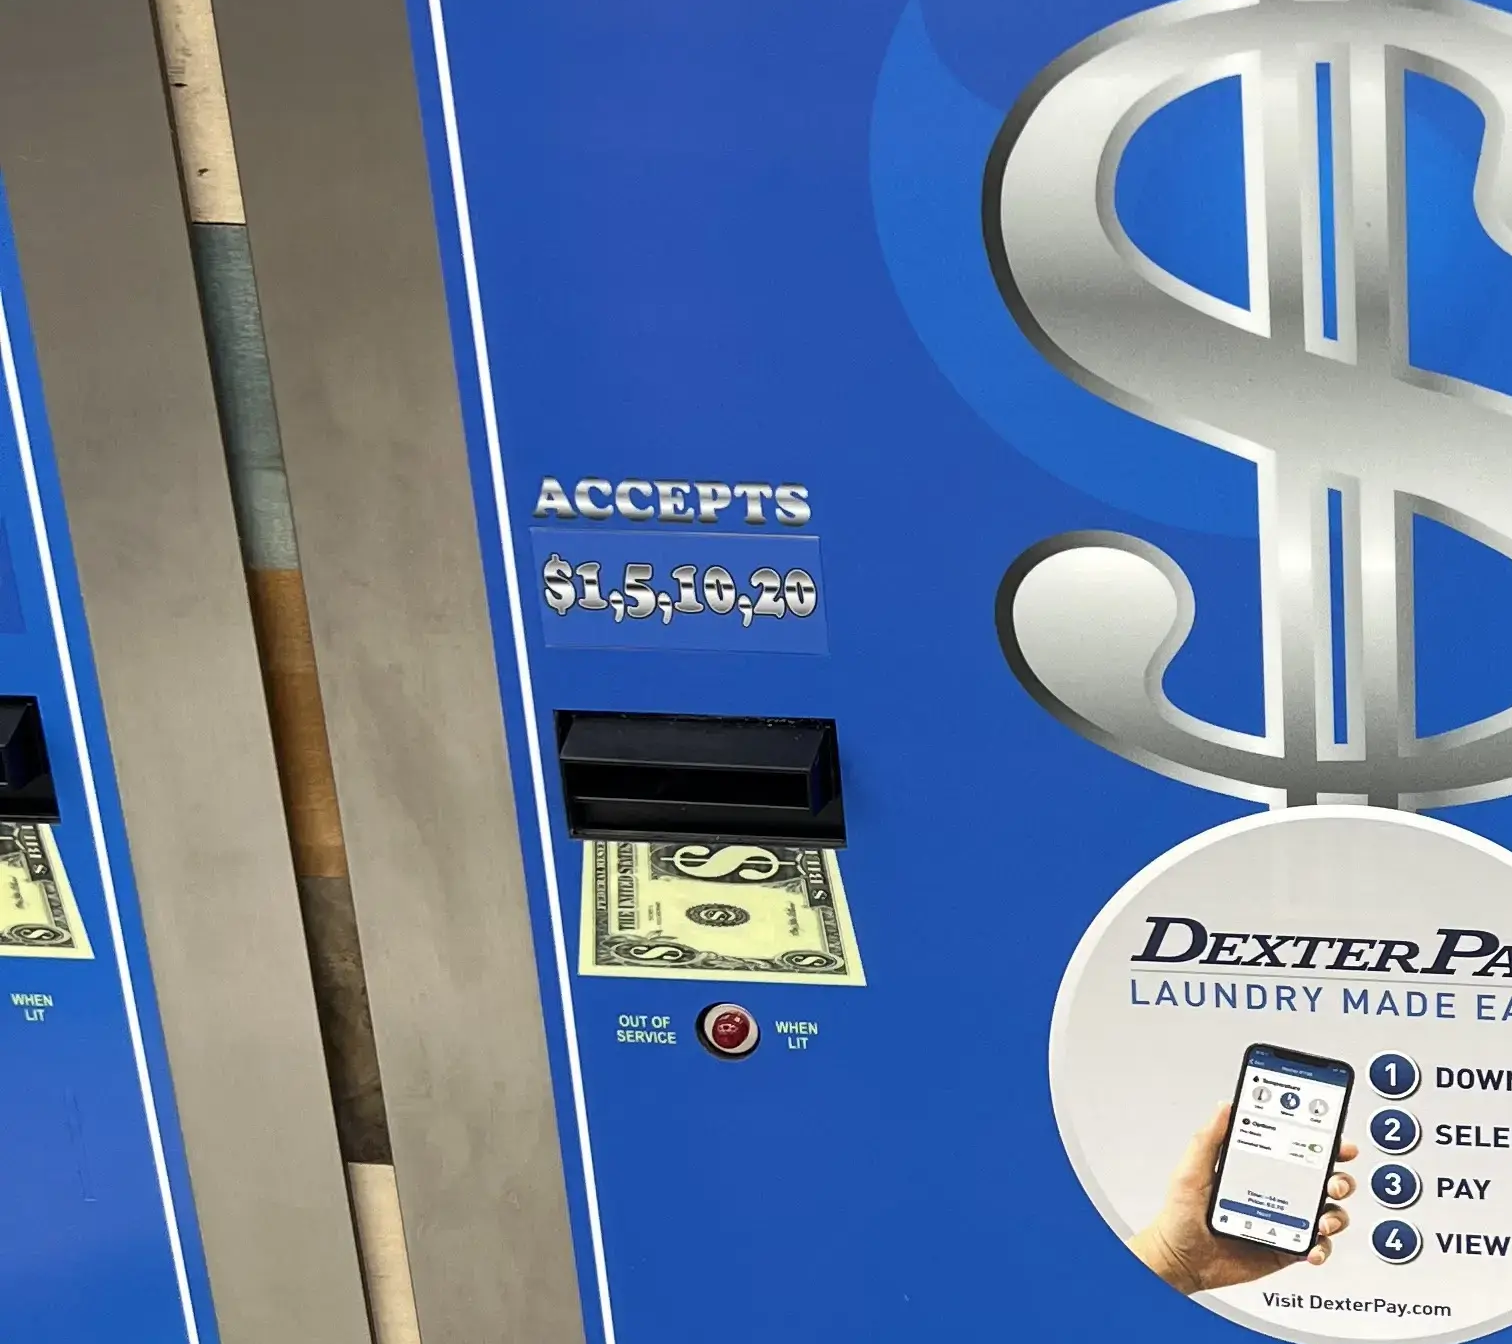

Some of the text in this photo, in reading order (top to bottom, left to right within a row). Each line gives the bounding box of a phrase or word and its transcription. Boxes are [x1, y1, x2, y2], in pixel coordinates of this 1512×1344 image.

[532, 476, 813, 526] ACCEPTS
[542, 553, 818, 627] $1,5,10,20
[618, 875, 635, 909] UNITED
[618, 911, 635, 931] THE
[11, 993, 53, 1007] WHEN
[1131, 978, 1323, 1013] LAUNDRY
[1343, 987, 1456, 1019] MADE
[24, 1009, 45, 1022] LIT
[618, 1014, 671, 1029] OUT OF
[775, 1020, 818, 1035] WHEN
[616, 1029, 677, 1045] SERVICE
[787, 1036, 809, 1049] LIT
[1384, 1062, 1397, 1086] 1
[1384, 1117, 1401, 1141] 2
[1384, 1172, 1491, 1200] 3 PAY
[1384, 1228, 1511, 1257] 4 VIEW
[1263, 1292, 1452, 1317] Visit DexterPay.com
